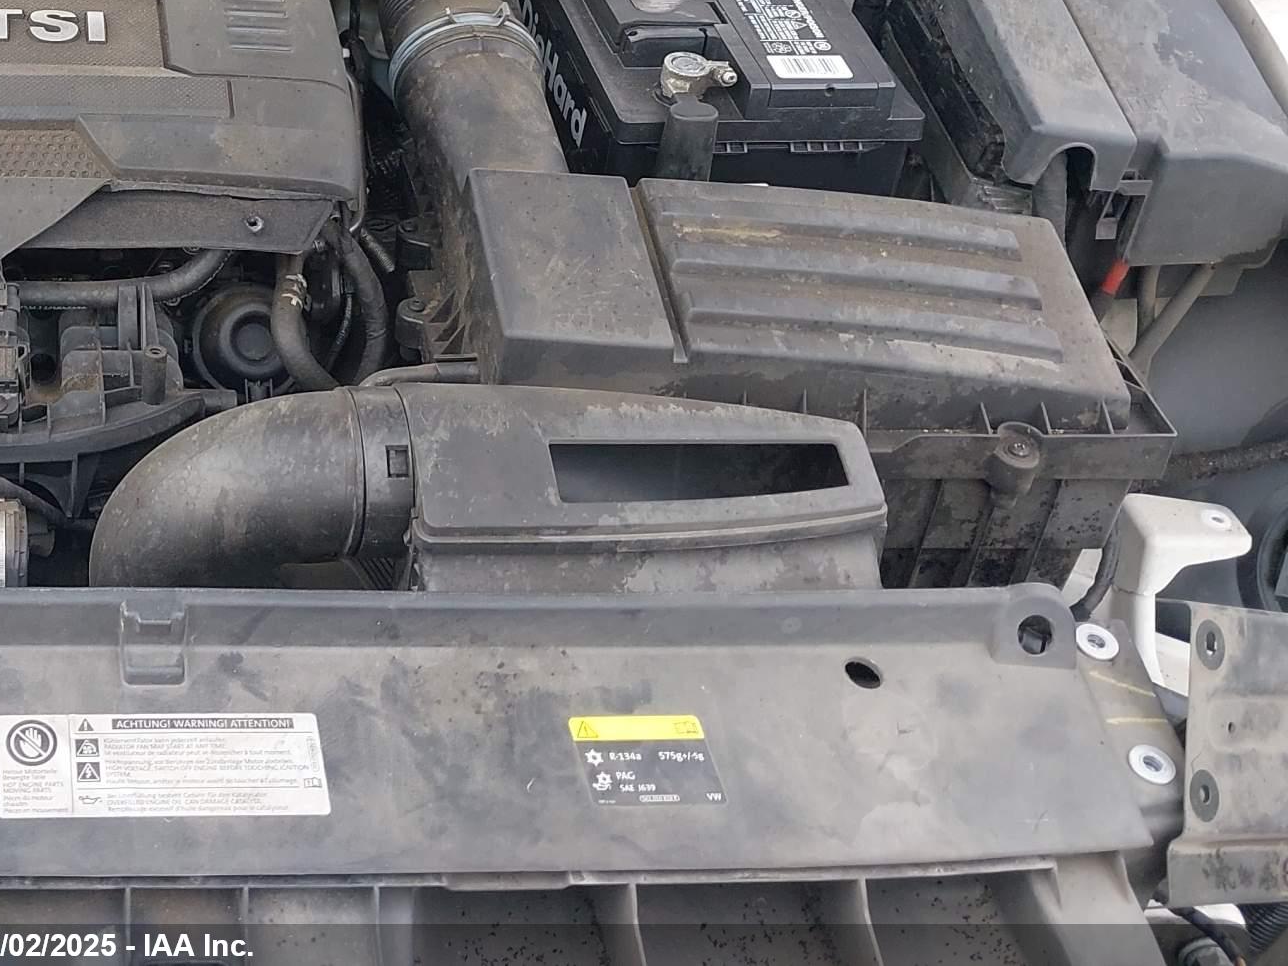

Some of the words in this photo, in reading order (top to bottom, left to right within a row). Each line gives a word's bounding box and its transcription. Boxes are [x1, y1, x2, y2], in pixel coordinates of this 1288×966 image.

[116, 719, 171, 729] ACHTUNG!
[173, 719, 228, 729] WARNING!
[230, 719, 290, 729] ATTENTION!
[615, 771, 636, 780] PAG
[706, 793, 722, 801] VW
